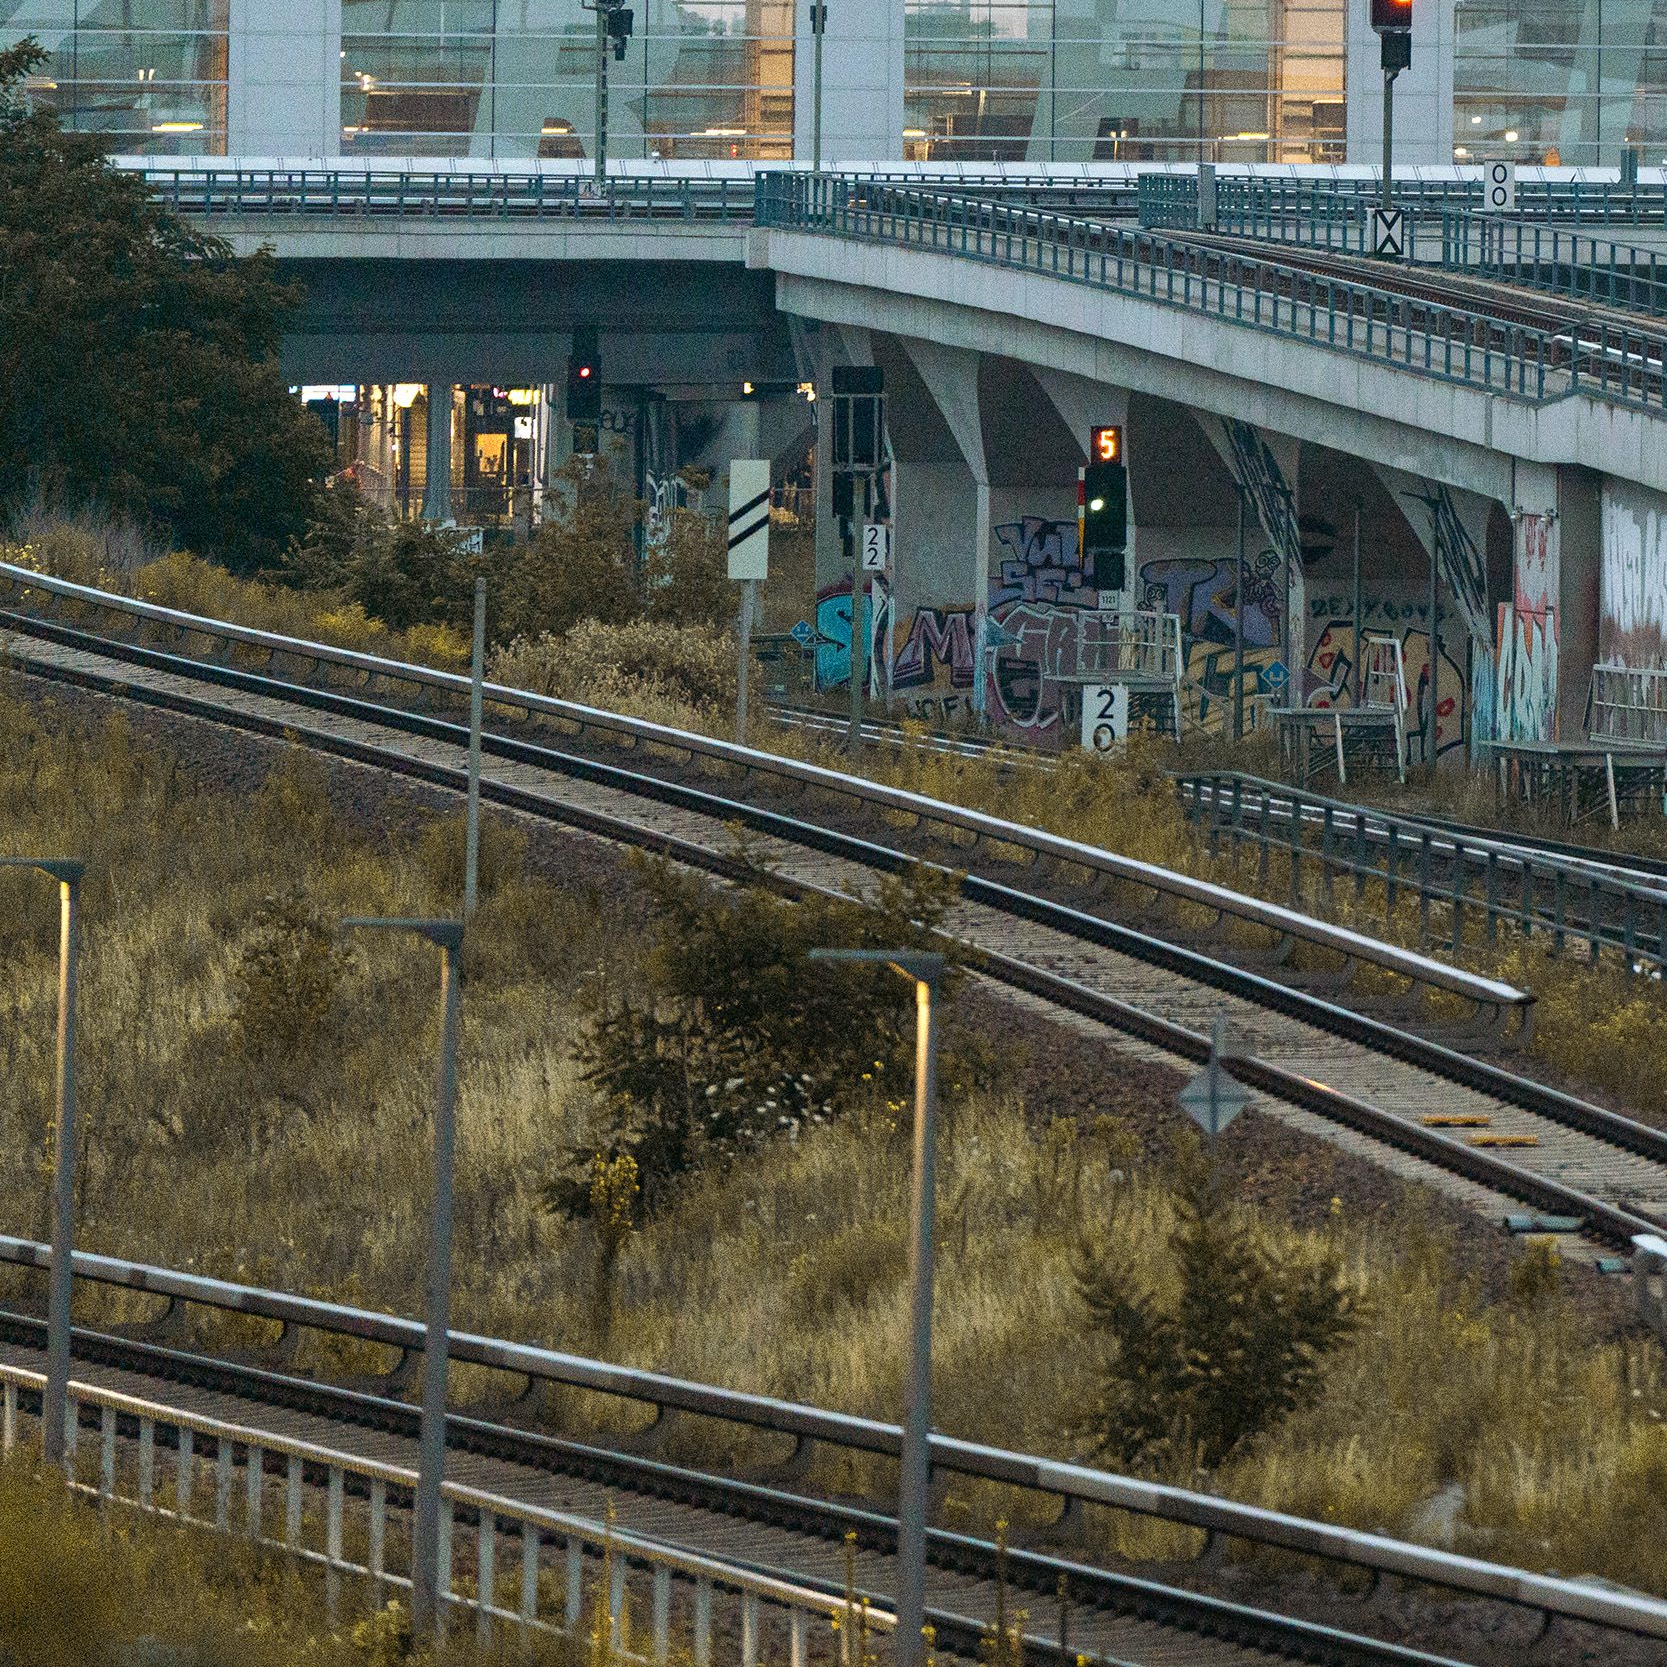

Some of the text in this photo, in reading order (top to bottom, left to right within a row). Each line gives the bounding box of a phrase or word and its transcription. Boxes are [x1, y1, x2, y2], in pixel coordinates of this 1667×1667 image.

[1100, 430, 1115, 459] 5
[867, 528, 879, 545] 2
[867, 547, 879, 566] 2
[1096, 689, 1115, 719] 2
